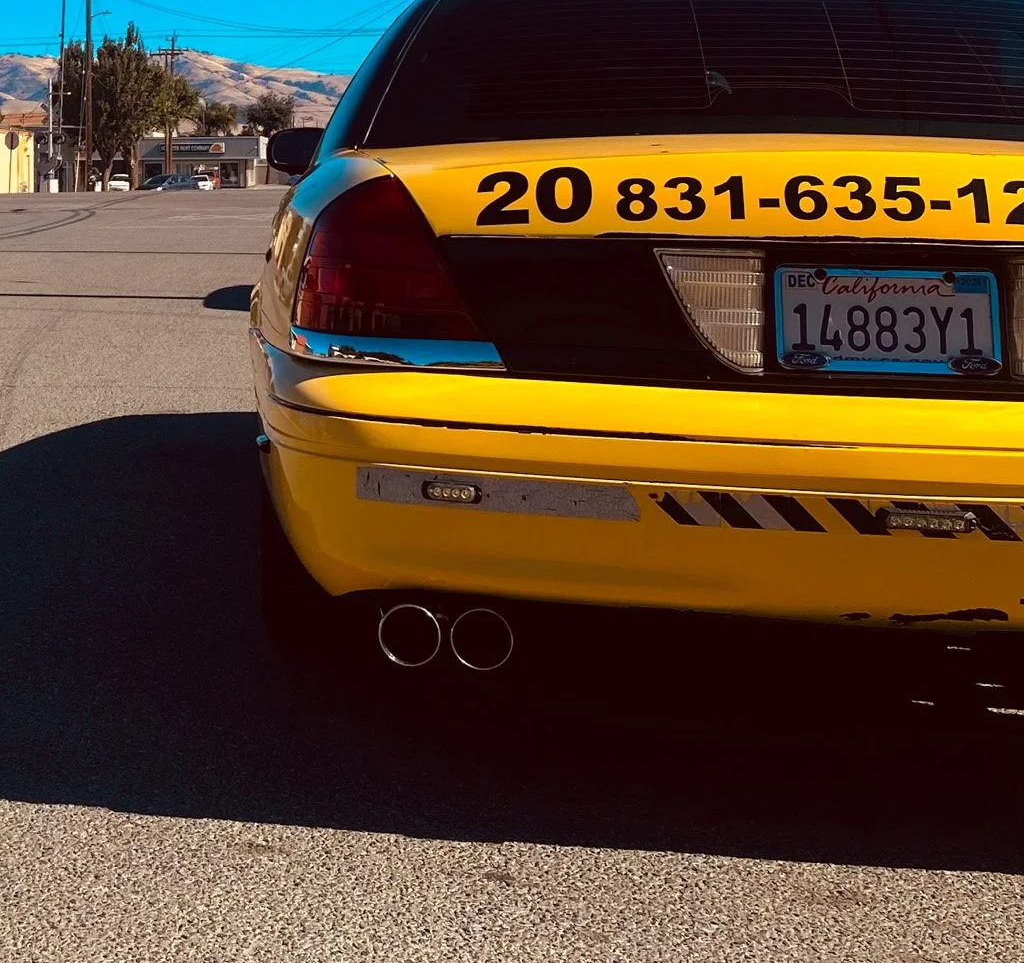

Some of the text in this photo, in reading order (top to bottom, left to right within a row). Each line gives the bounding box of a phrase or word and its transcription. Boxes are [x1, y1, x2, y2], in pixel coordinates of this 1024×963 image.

[476, 166, 593, 227] 20
[787, 274, 816, 288] DEC
[821, 275, 955, 303] California
[791, 302, 984, 356] 14883Y1
[791, 353, 820, 365] Ford
[961, 358, 989, 370] Ford
